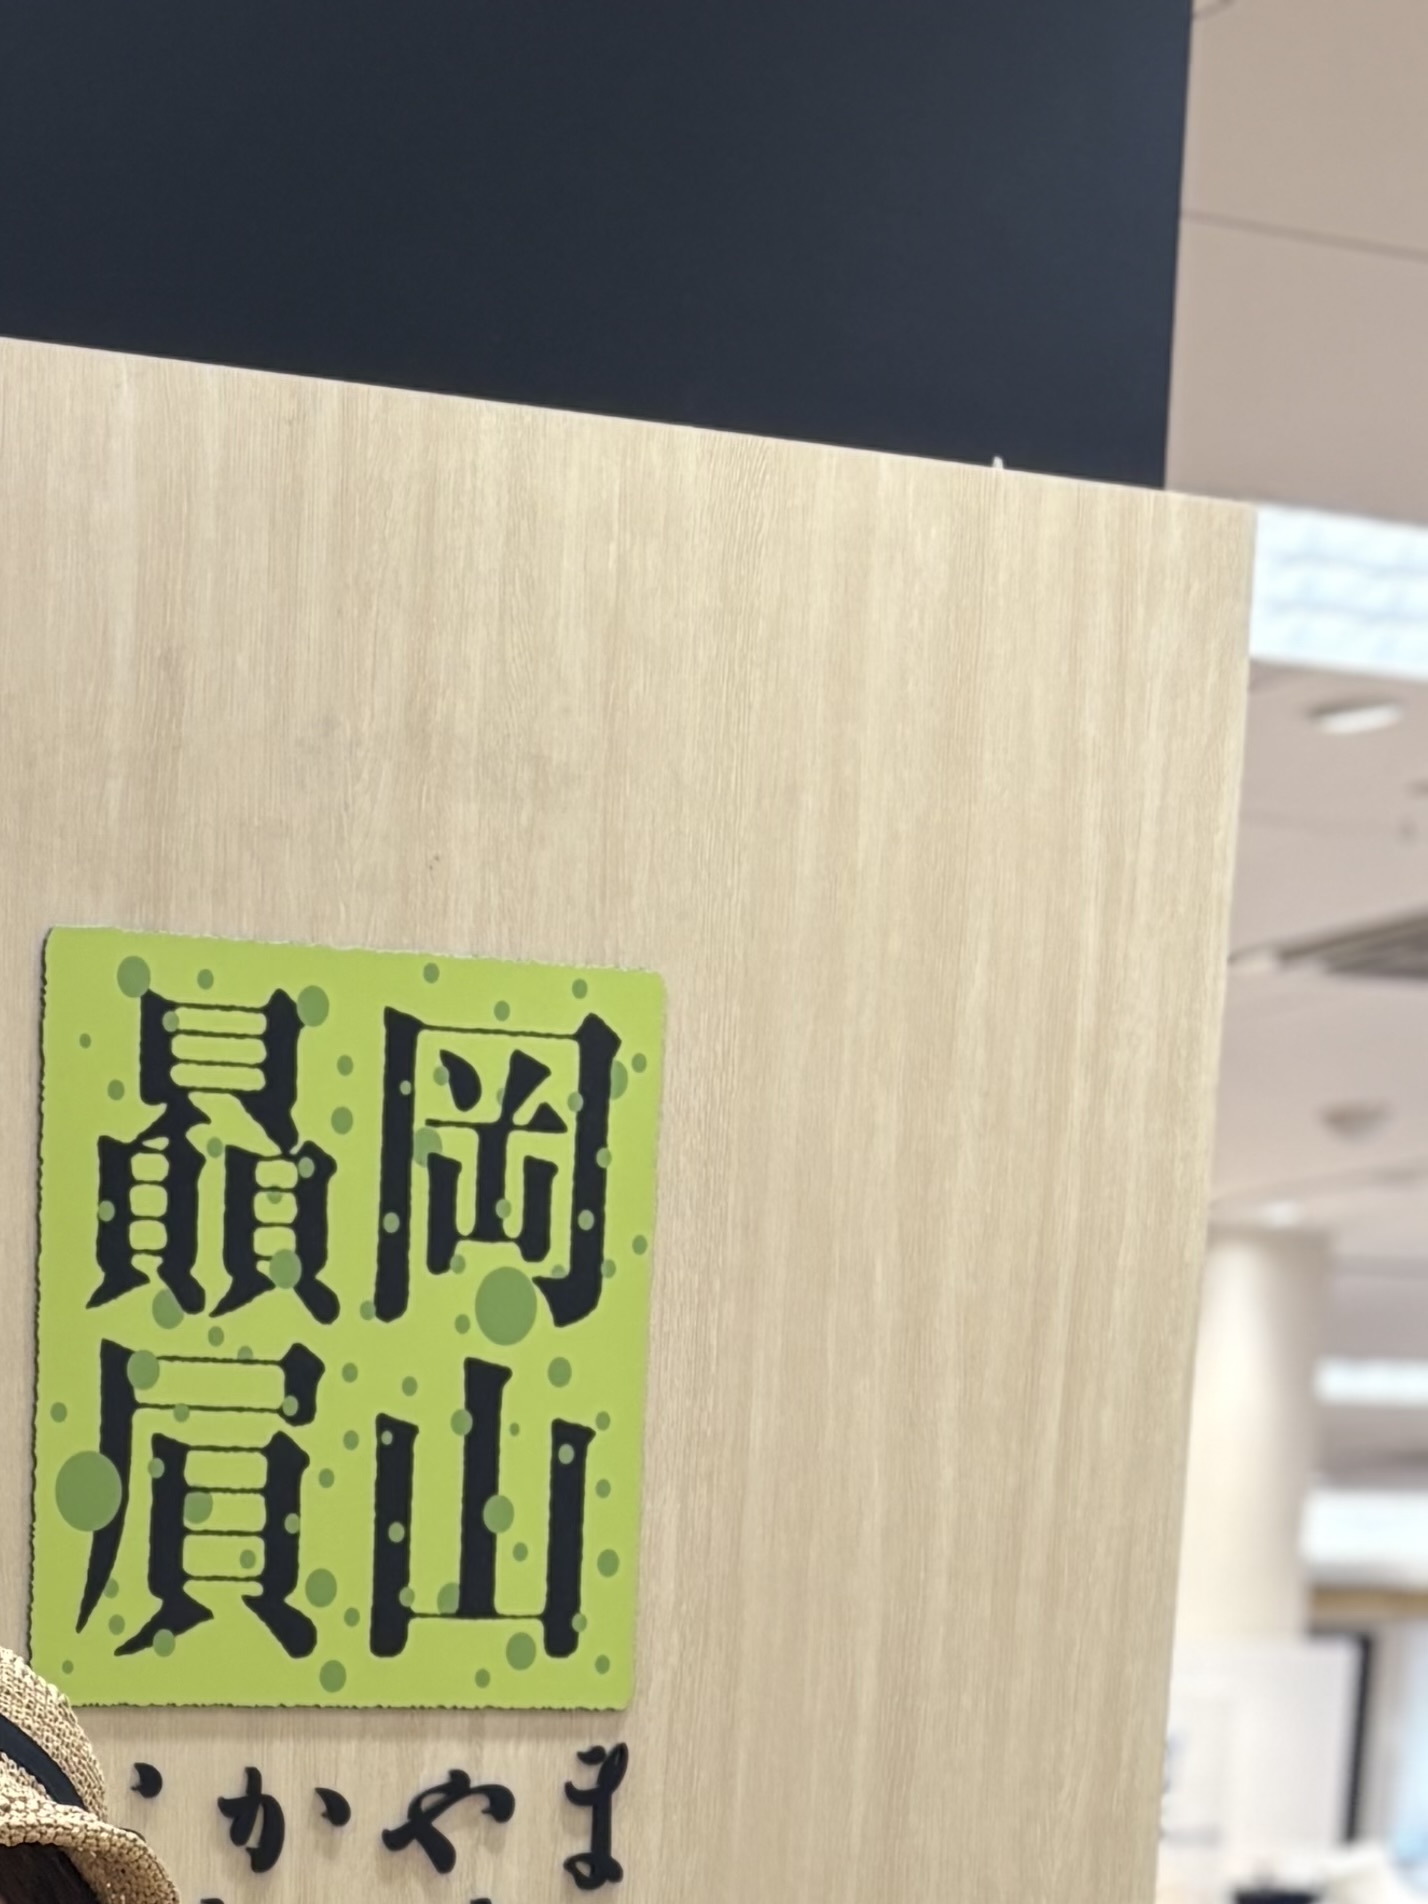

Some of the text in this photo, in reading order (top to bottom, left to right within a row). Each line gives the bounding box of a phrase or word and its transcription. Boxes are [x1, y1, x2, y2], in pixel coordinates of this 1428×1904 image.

[370, 1006, 621, 1658] 岡山
[131, 1742, 629, 1891] かやま
